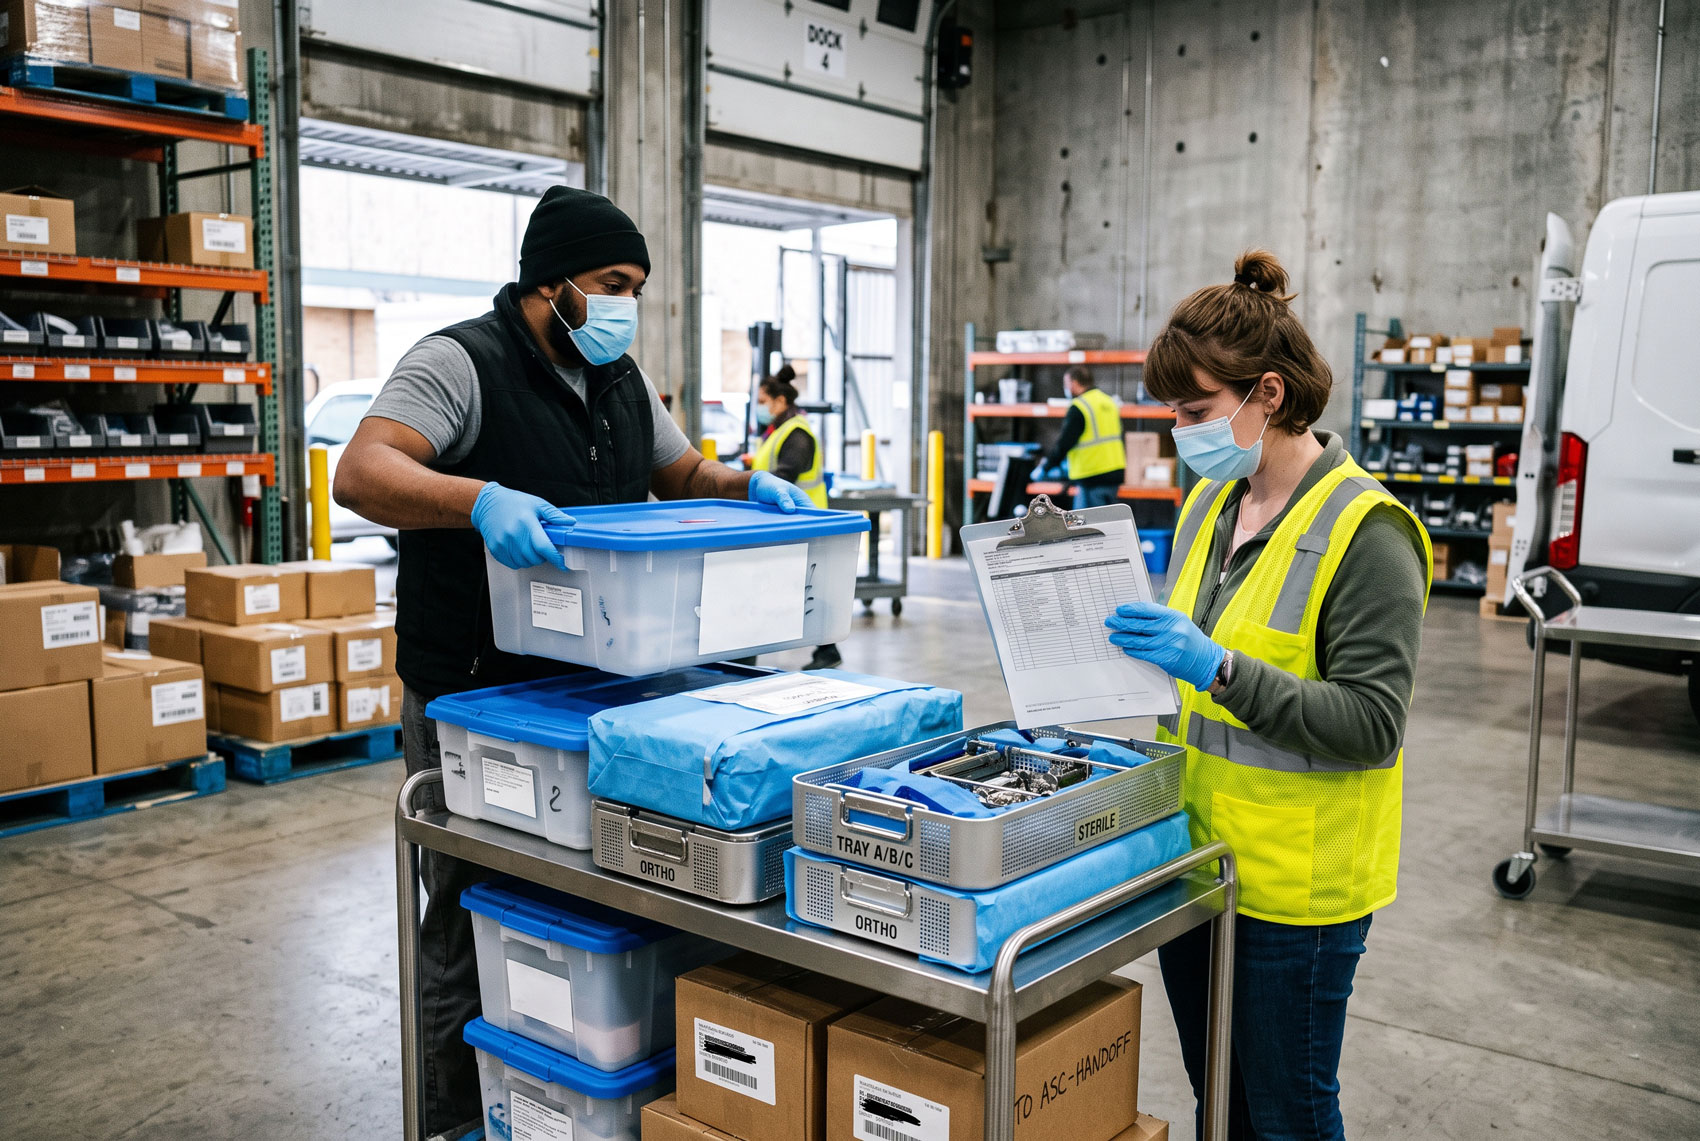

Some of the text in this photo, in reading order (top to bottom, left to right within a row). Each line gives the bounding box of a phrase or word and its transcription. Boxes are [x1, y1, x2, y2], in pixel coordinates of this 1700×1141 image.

[808, 24, 843, 50] DOCK
[821, 52, 829, 70] 4
[549, 785, 562, 812] 2
[1078, 813, 1116, 841] STERILE
[836, 835, 914, 869] TRAY A/B/C
[640, 860, 675, 882] ORTHO
[855, 915, 897, 940] ORTHO
[1014, 1030, 1131, 1125] TO ASC-HANDOFF
